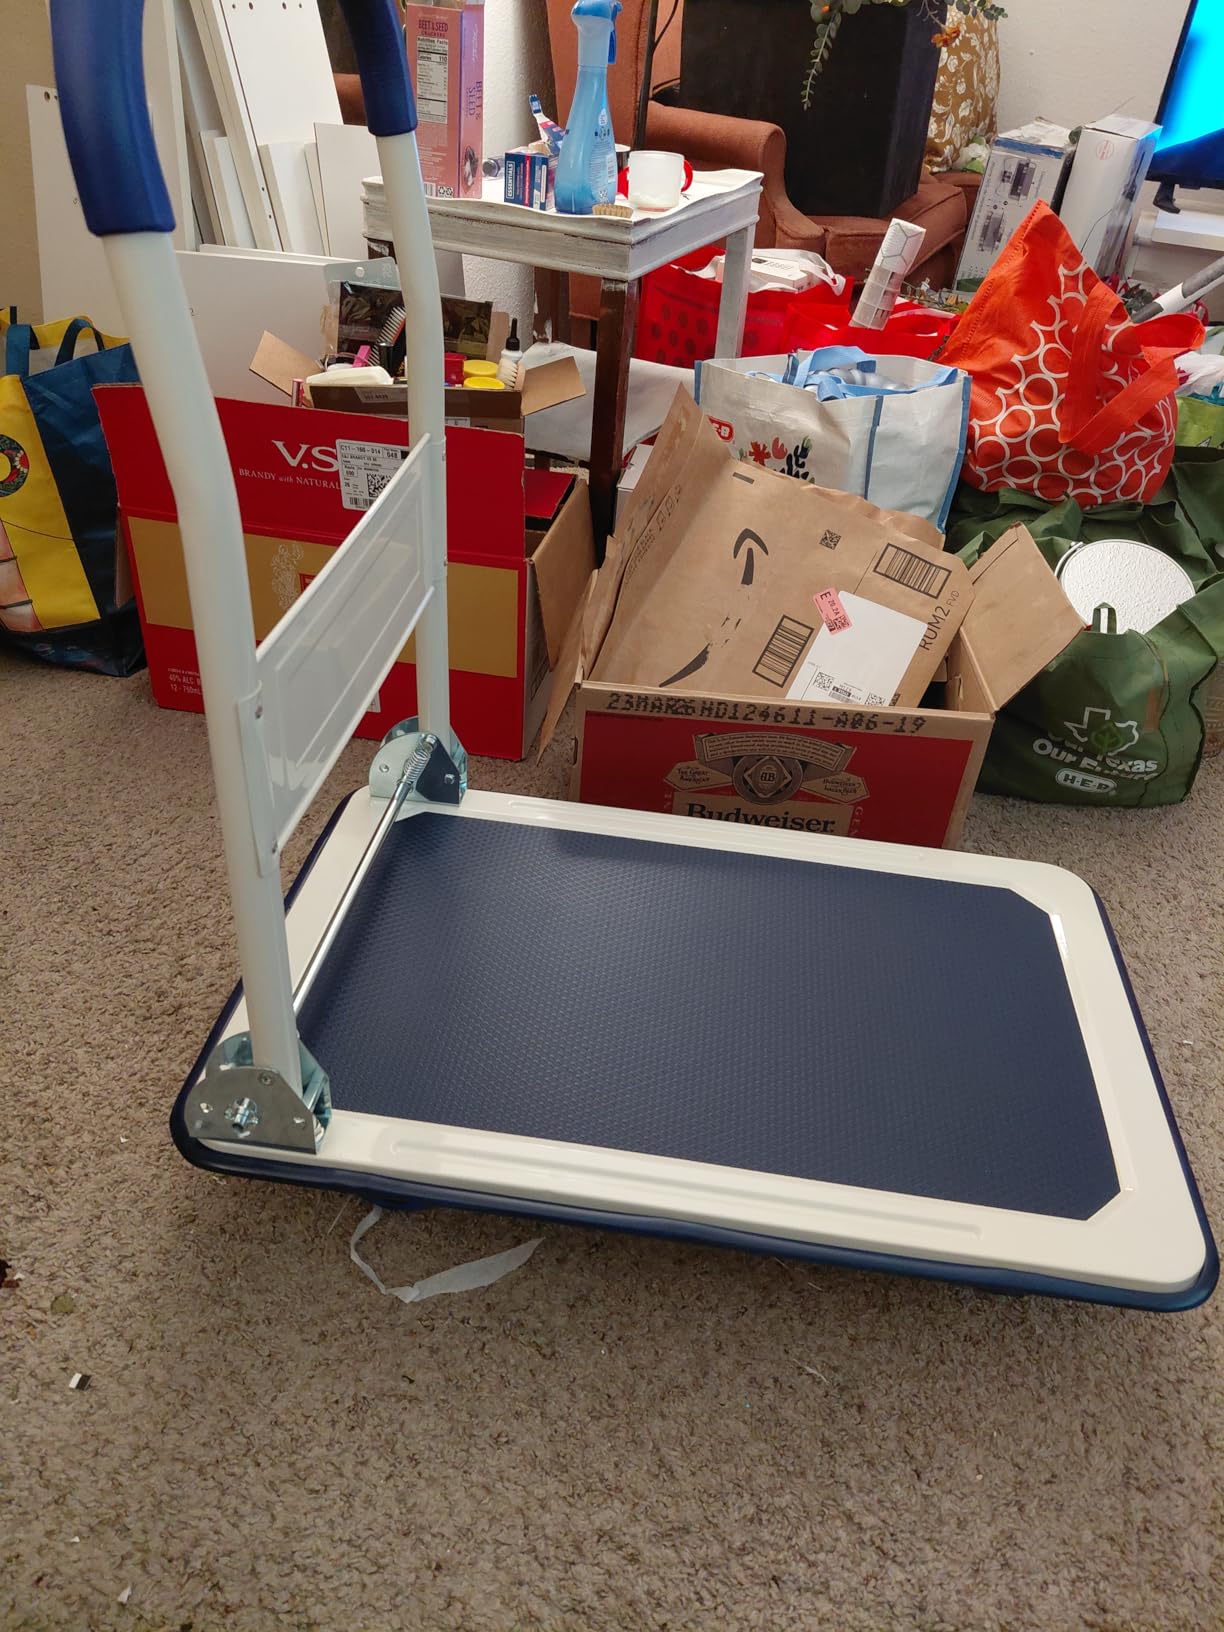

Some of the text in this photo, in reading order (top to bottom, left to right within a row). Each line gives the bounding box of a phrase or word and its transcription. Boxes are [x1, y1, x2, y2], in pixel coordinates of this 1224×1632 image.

[435, 22, 449, 32] SEED
[468, 86, 476, 116] SEED
[475, 81, 483, 107] BEET
[239, 468, 277, 481] BRANDY
[278, 476, 294, 484] with
[295, 476, 342, 491] NATURAL
[820, 591, 831, 600] E
[919, 590, 960, 651] RUM2 FVD
[1032, 738, 1077, 763] Our
[687, 803, 836, 833] Budweiser
